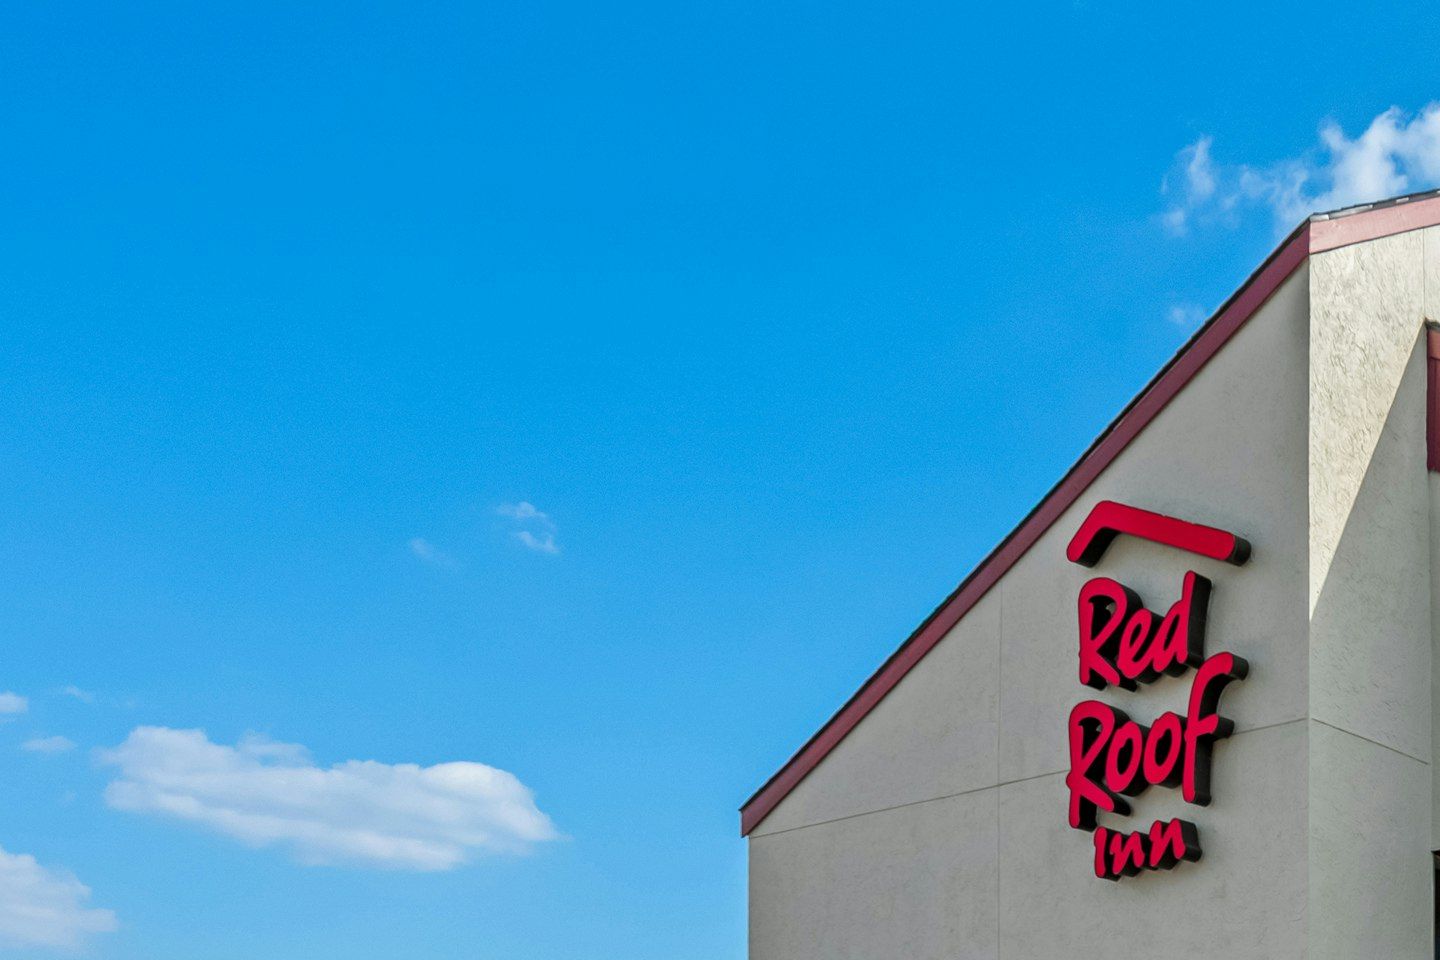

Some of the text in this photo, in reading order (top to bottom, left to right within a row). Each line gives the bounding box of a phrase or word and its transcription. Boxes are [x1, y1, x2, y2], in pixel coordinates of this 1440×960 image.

[1078, 570, 1208, 690] Red
[1066, 651, 1244, 830] Roof
[1094, 818, 1199, 879] Inn
